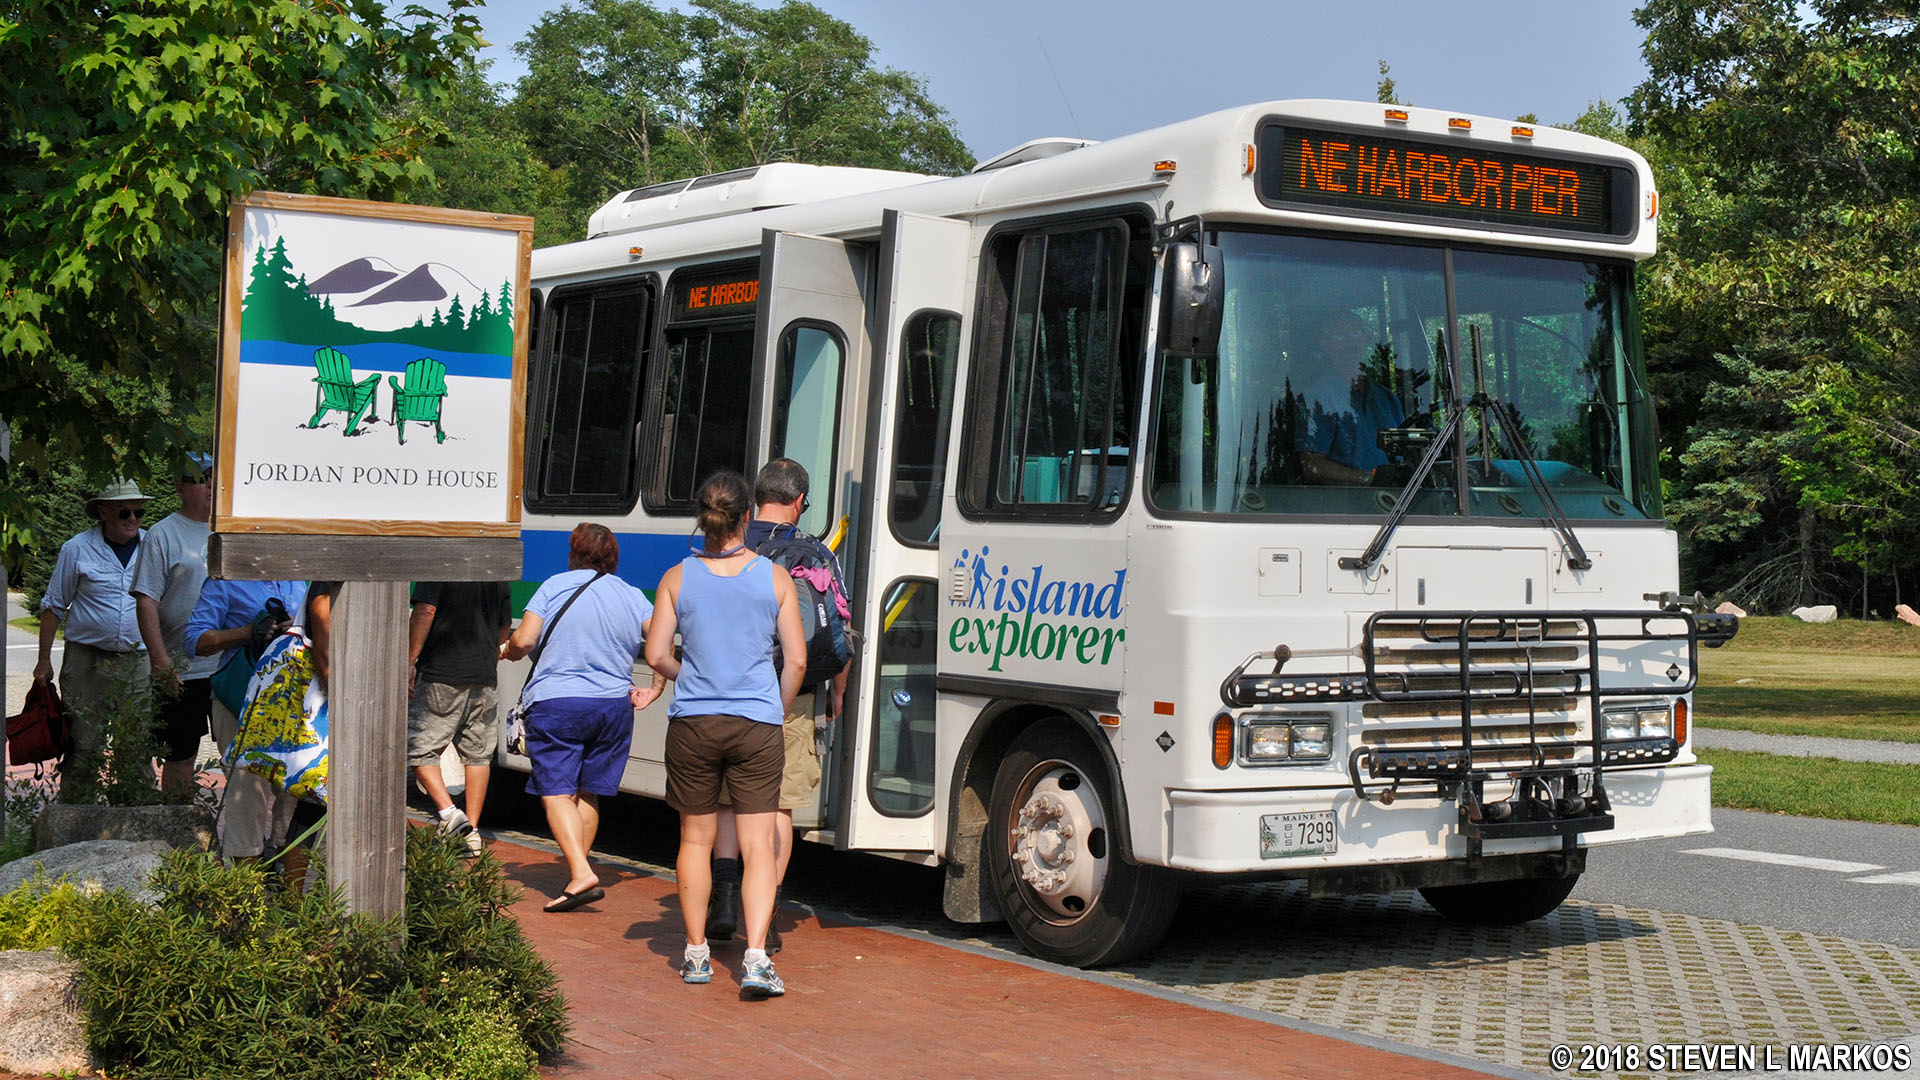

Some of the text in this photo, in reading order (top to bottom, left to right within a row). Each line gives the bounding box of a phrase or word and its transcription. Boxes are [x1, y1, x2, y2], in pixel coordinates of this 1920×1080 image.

[1301, 138, 1581, 217] NE HARBOR PIER
[689, 286, 708, 309] NE
[244, 462, 499, 489] JORDAN POND HOUSE
[992, 565, 1127, 620] island
[949, 612, 1126, 673] explorer
[1282, 813, 1316, 822] MAINE
[1284, 823, 1294, 847] BUS
[1298, 821, 1334, 845] 7299
